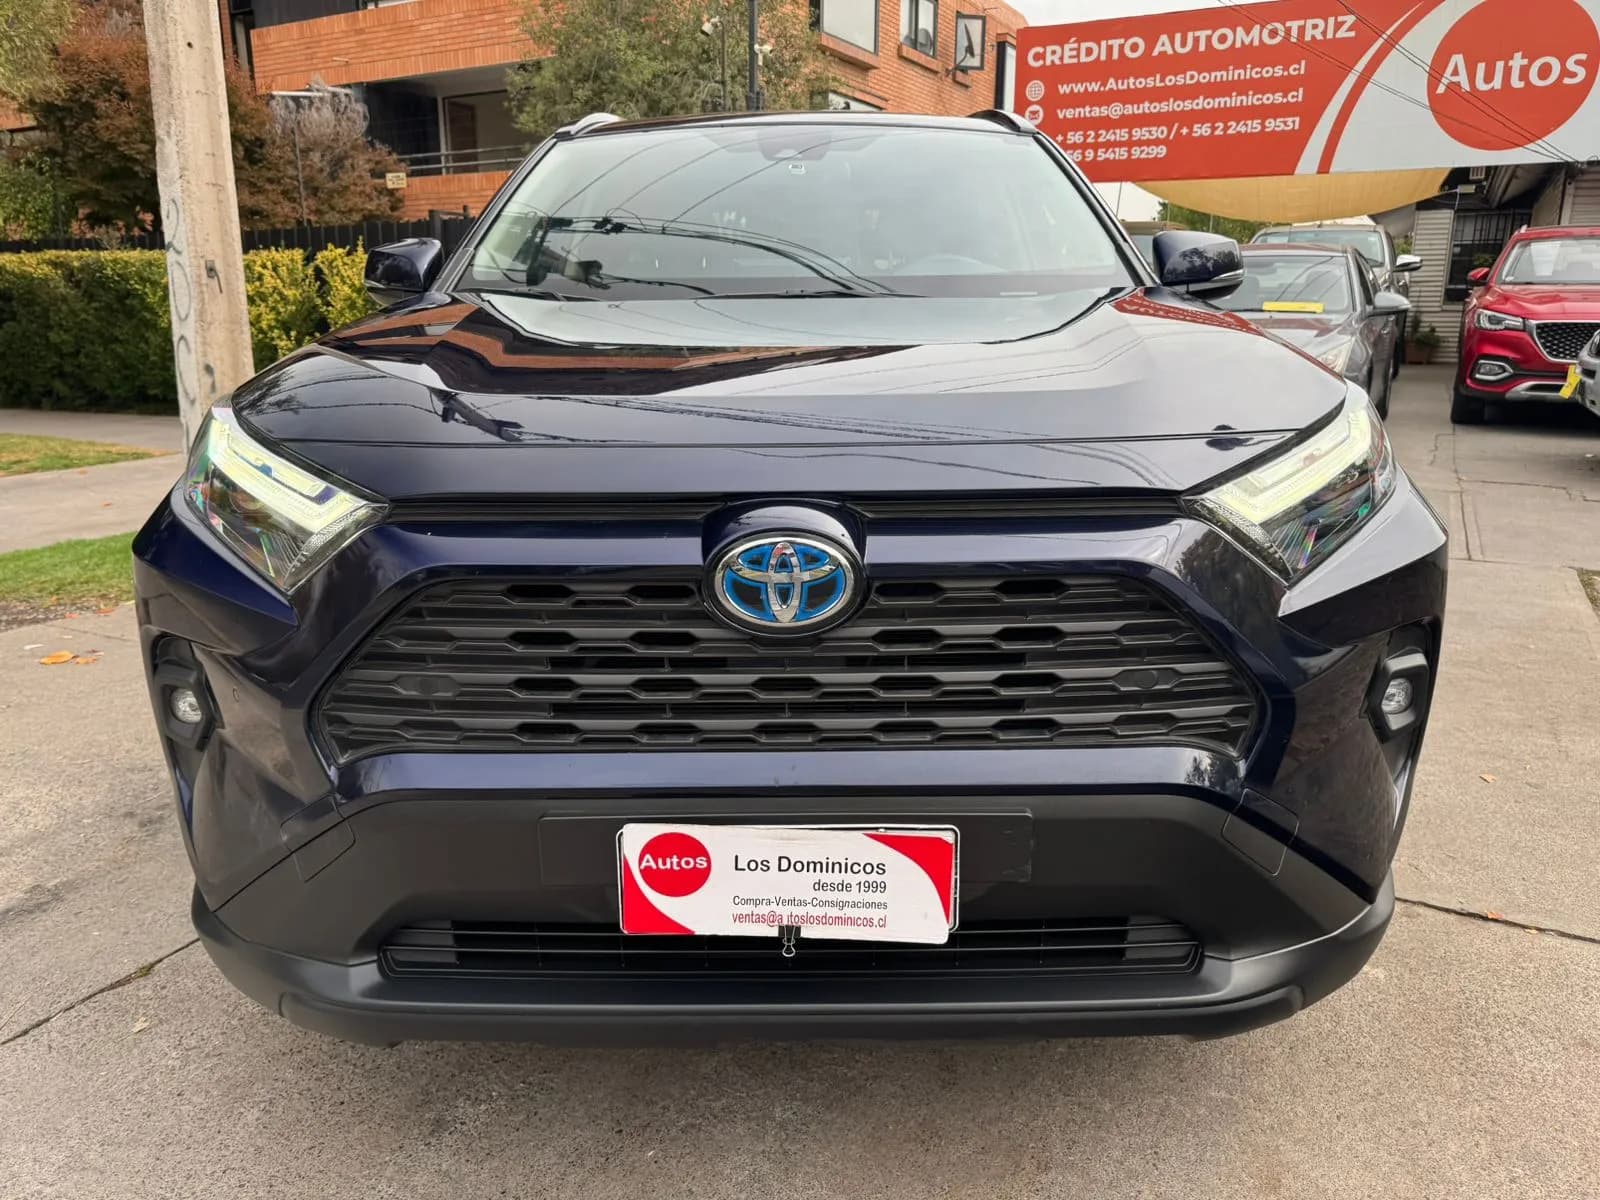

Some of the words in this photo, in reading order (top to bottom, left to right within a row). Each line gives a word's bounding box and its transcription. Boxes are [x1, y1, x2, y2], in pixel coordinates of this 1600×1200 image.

[1027, 37, 1145, 67] CRÉDITO
[1152, 14, 1356, 57] AUTOMOTRIZ
[1058, 60, 1306, 95] www.AutosLosDominicos.cl
[1436, 51, 1588, 95] Autos
[1057, 88, 1304, 119] ventas@autoslosdominicos.cl
[1066, 131, 1084, 144] 56
[1086, 131, 1095, 143] 2
[1098, 128, 1129, 142] 2415
[1132, 126, 1168, 141] 9530
[1192, 123, 1212, 137] 56
[1214, 122, 1224, 135] 2
[1227, 119, 1262, 134] 2415
[1264, 116, 1300, 132] 9531
[1085, 148, 1094, 161] 9
[1097, 147, 1129, 160] 5415
[1131, 145, 1167, 159] 9299
[639, 853, 708, 870] Autos
[734, 855, 770, 872] Los
[777, 856, 887, 875] Dominicos
[813, 879, 852, 893] desde
[856, 880, 887, 893] 1999
[732, 895, 888, 911] Compra-Ventas-Consignaciones
